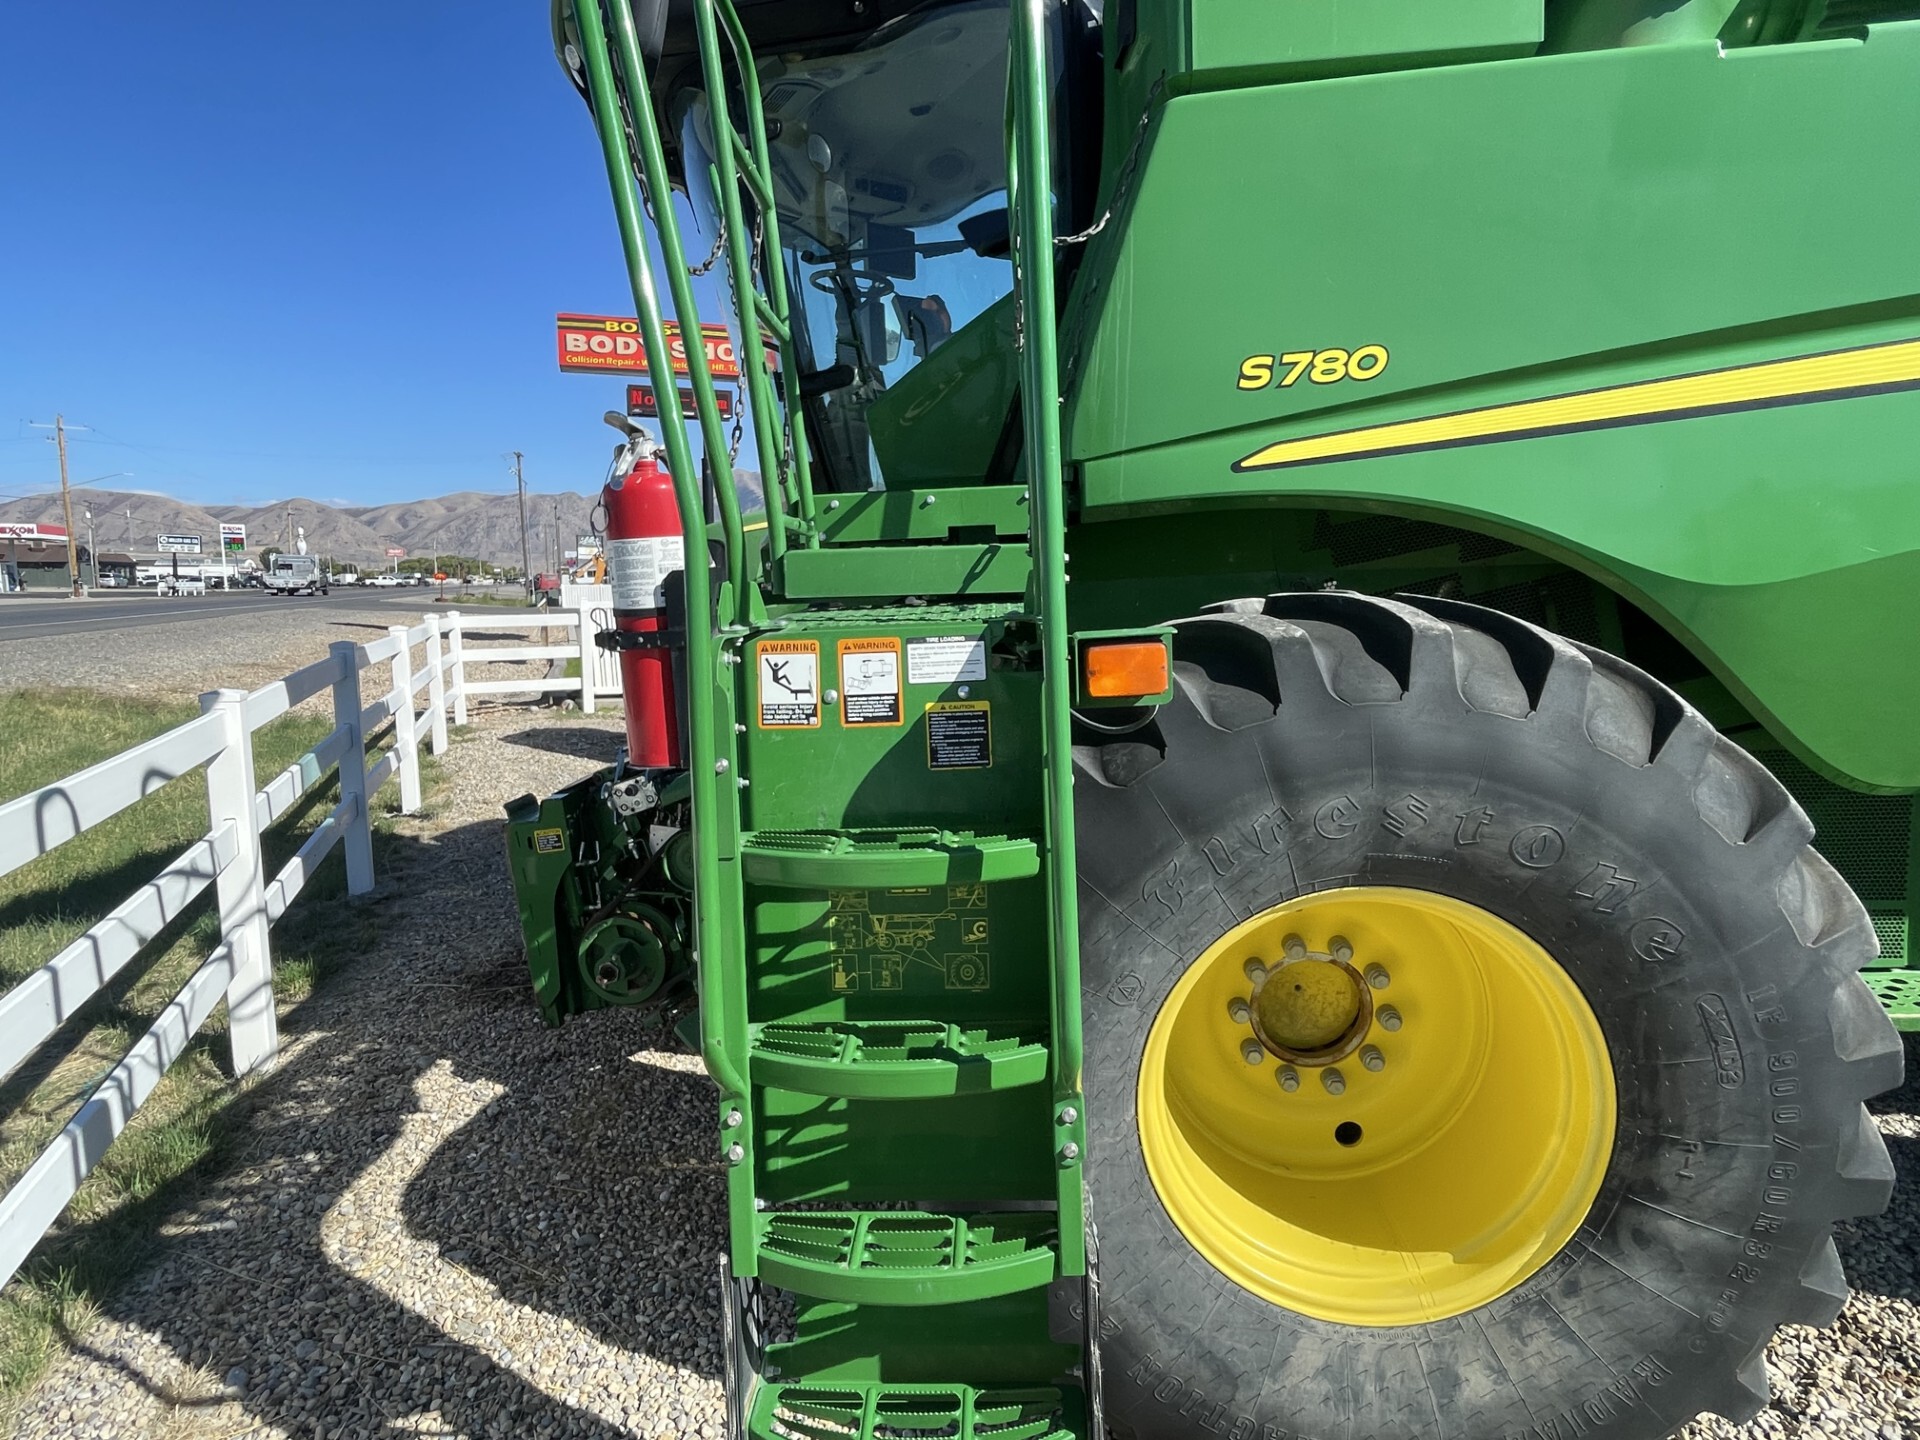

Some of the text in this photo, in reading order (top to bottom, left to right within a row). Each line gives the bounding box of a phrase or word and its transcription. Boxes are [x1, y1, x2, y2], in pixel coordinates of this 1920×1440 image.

[566, 354, 605, 364] Collision
[606, 357, 635, 367] Repair
[1237, 343, 1389, 391] S780
[0, 525, 35, 537] EXXON
[770, 643, 817, 652] WARNING
[853, 641, 896, 650] WARNING
[1142, 793, 1686, 961] Firestone
[1728, 1050, 1802, 1285] 900/60R32
